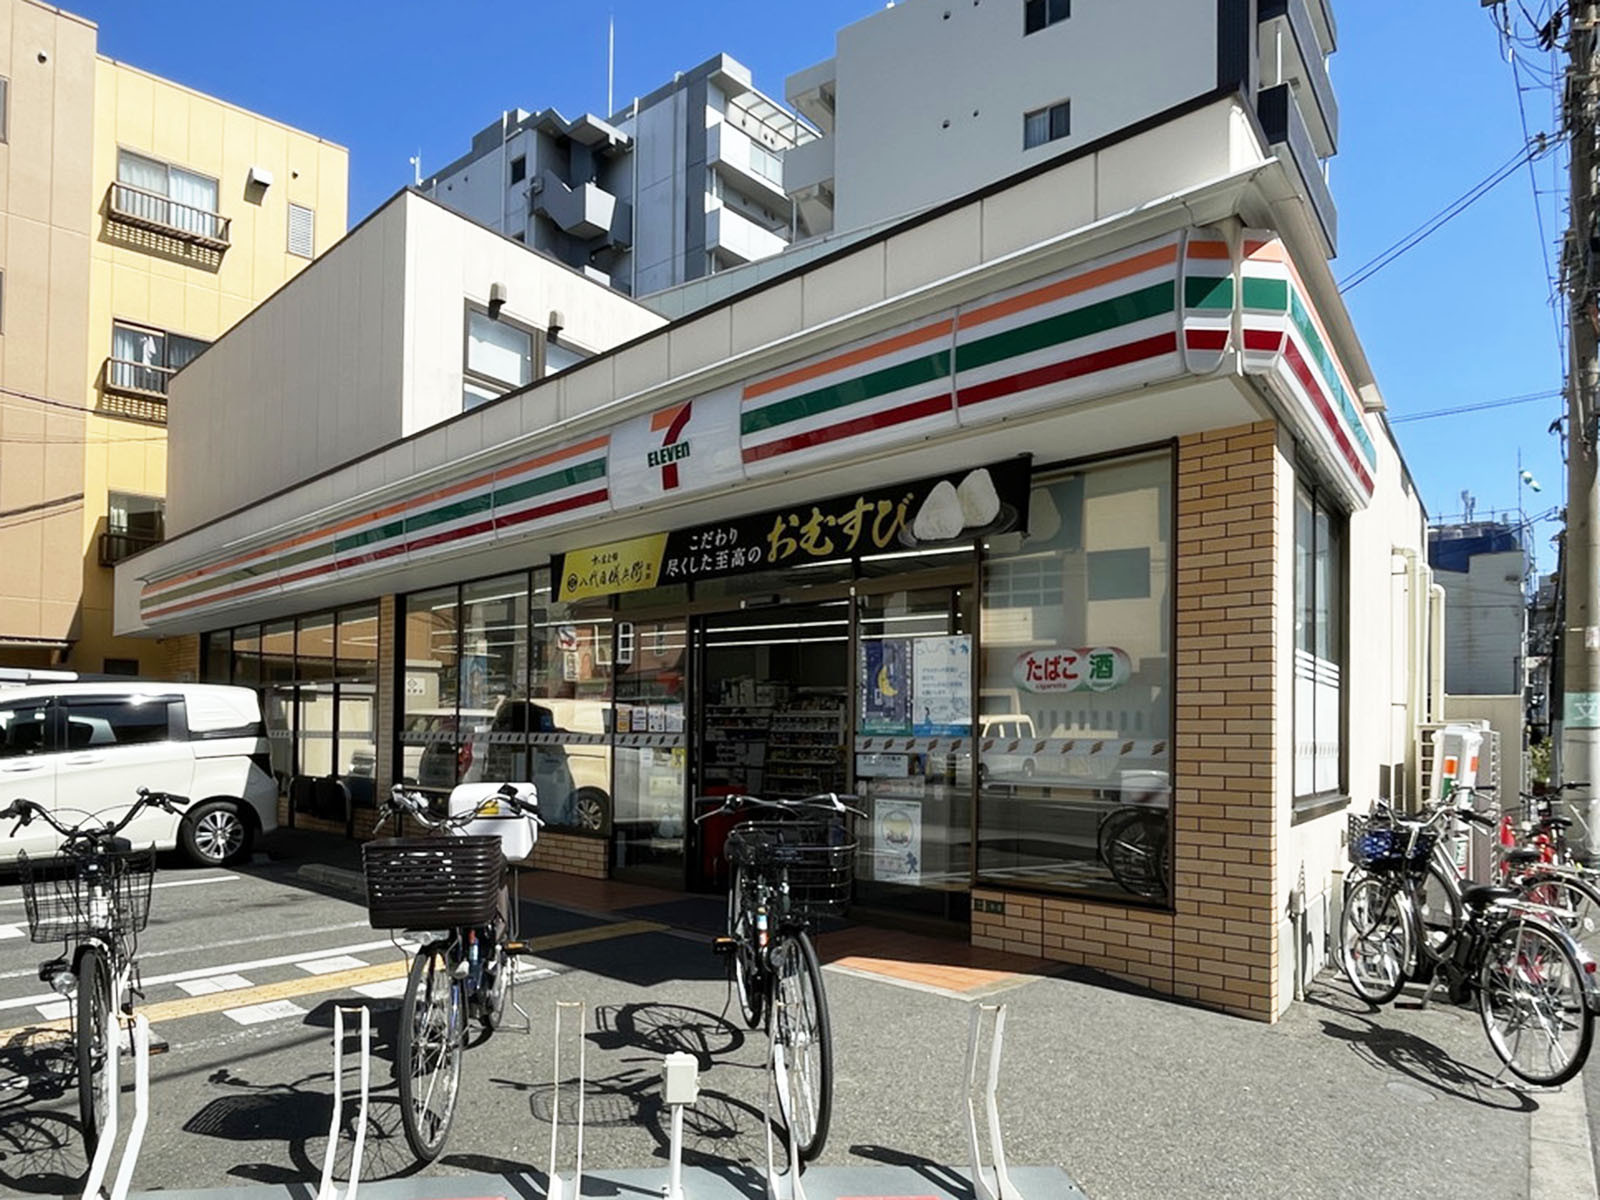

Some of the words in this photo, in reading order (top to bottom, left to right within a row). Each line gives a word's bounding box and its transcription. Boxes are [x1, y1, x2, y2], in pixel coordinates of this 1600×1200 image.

[689, 527, 738, 551] こだわり
[767, 492, 914, 563] おむすび
[665, 546, 762, 577] 尽くした至高の
[1026, 655, 1079, 682] たばこ
[1089, 653, 1114, 679] 酒
